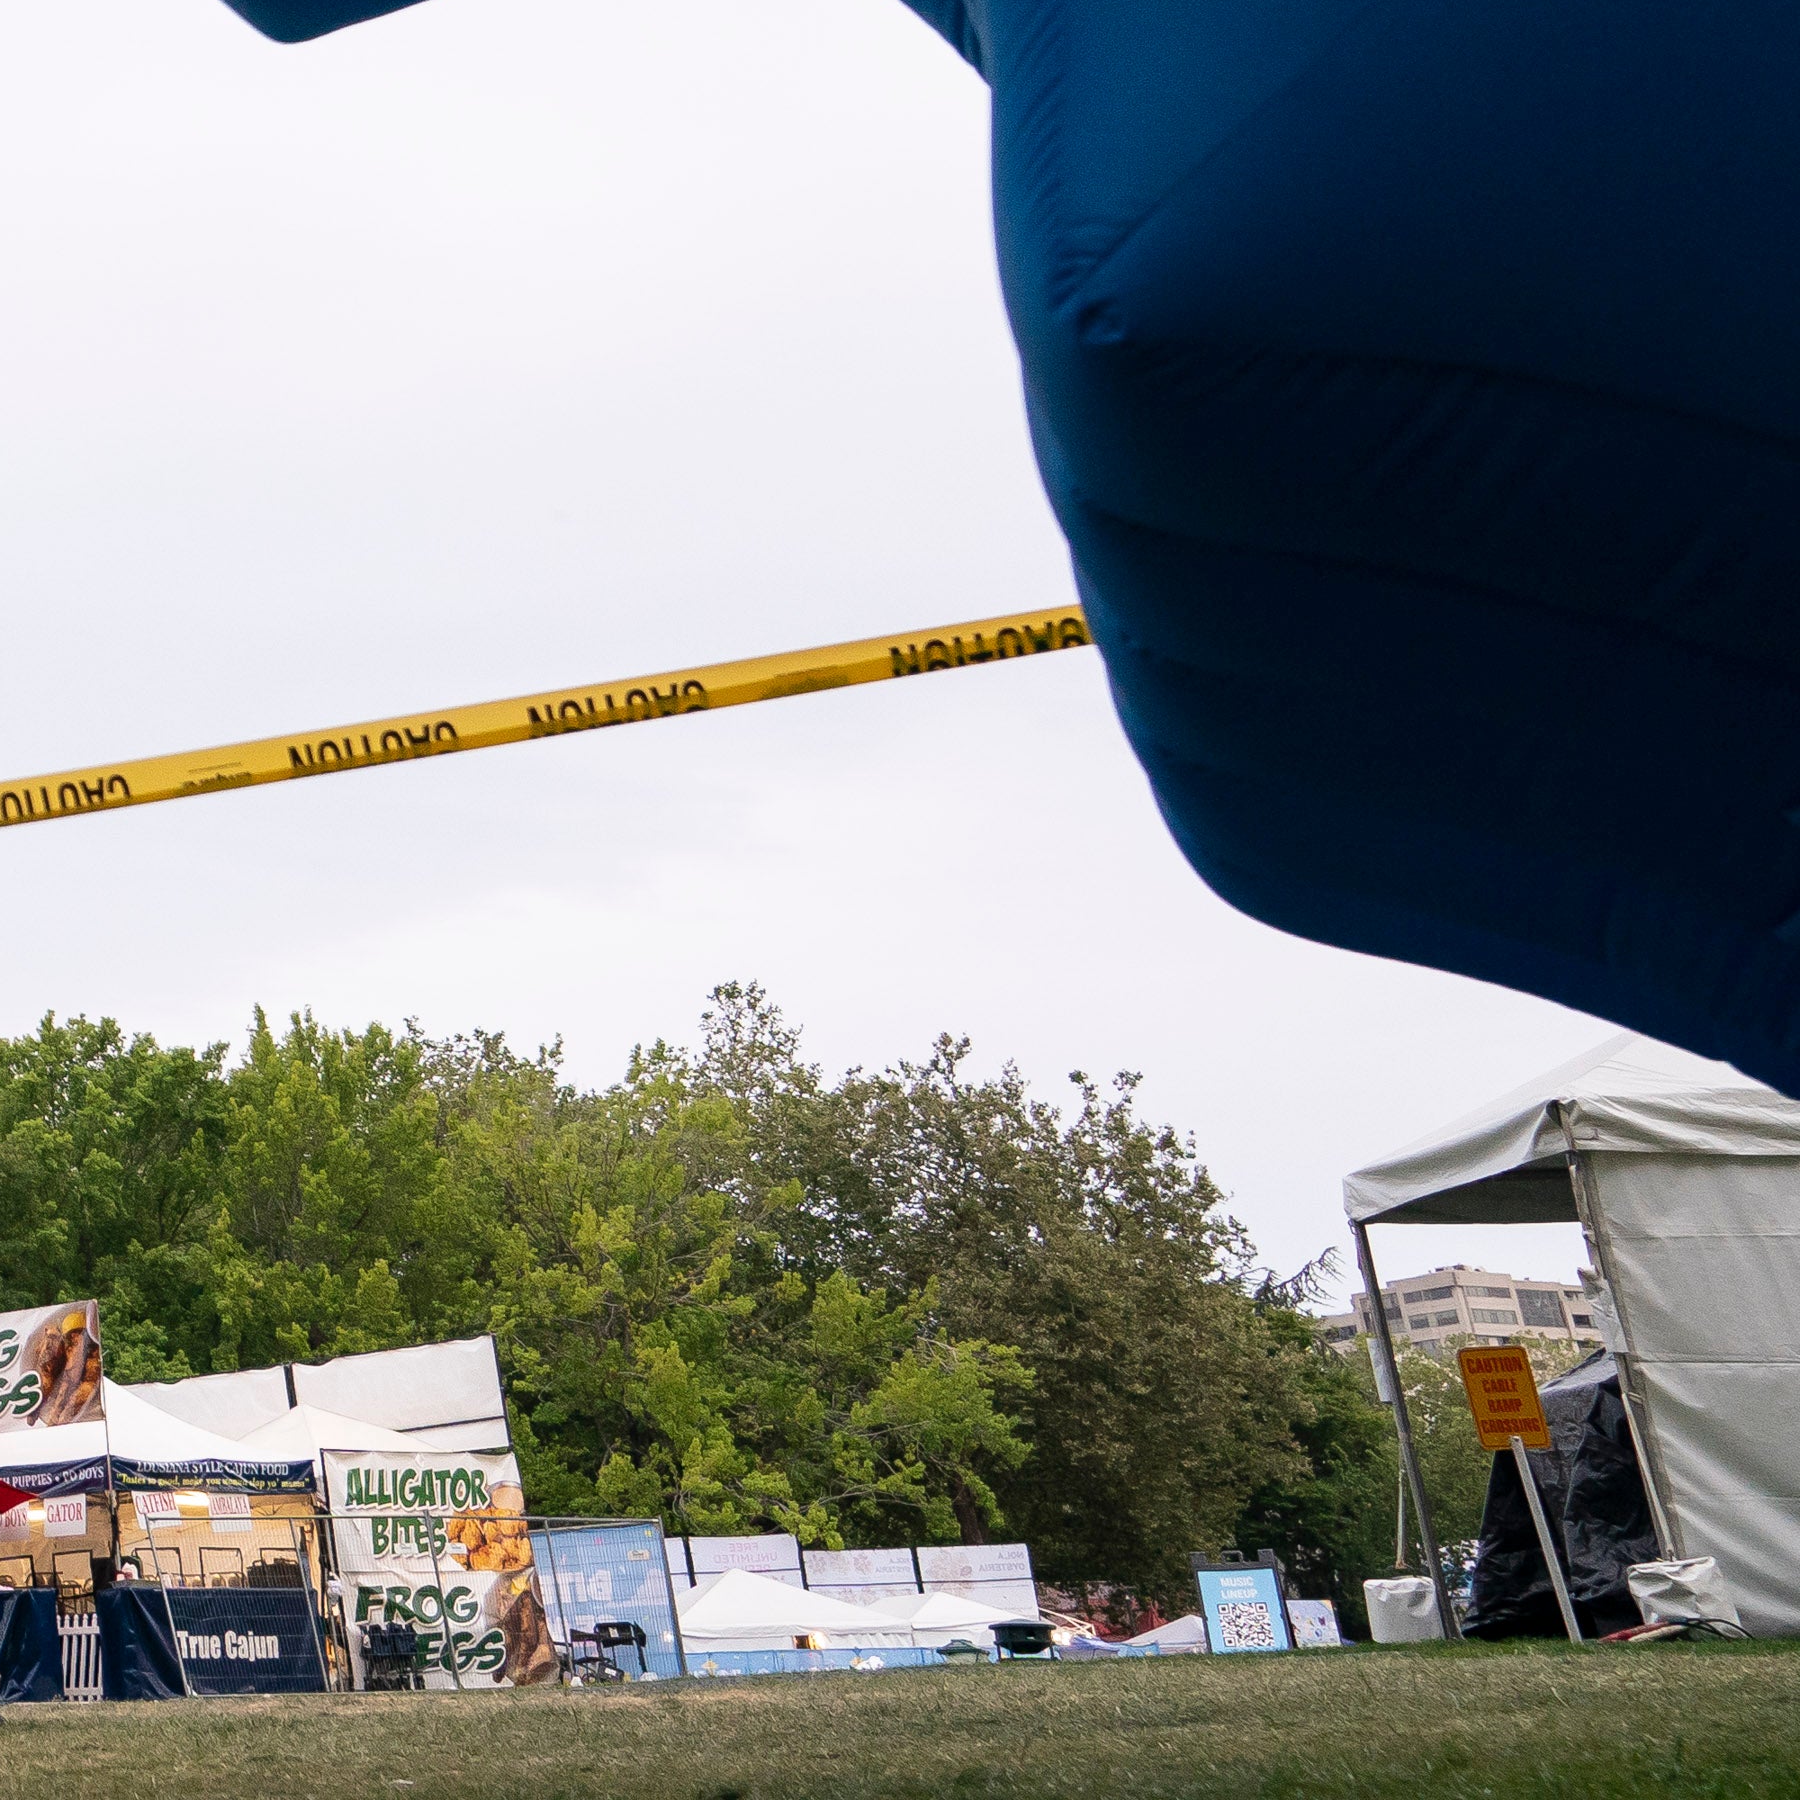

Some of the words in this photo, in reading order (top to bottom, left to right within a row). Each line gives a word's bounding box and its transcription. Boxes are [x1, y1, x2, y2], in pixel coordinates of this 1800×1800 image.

[1466, 1357, 1523, 1374] CAUTION
[1482, 1378, 1518, 1393] CABLE
[1488, 1399, 1522, 1413] RAMP
[1481, 1418, 1541, 1433] CROSSING
[12, 1473, 52, 1488] PUPPIES
[79, 1466, 104, 1479] BOYS
[224, 1462, 259, 1475] CAJUN
[261, 1463, 289, 1475] FOOD
[346, 1468, 488, 1508] ALLIGATOR
[47, 1502, 82, 1523] GATOR
[135, 1491, 176, 1514] CATFISH
[5, 1507, 27, 1528] BOYS
[372, 1517, 446, 1557] BITES
[1220, 1576, 1254, 1588] MUSIC
[1221, 1588, 1257, 1599] LINEUP
[355, 1585, 478, 1624] FROG
[177, 1630, 220, 1659] True
[225, 1630, 279, 1662] Cajun
[414, 1630, 504, 1673] EGS
